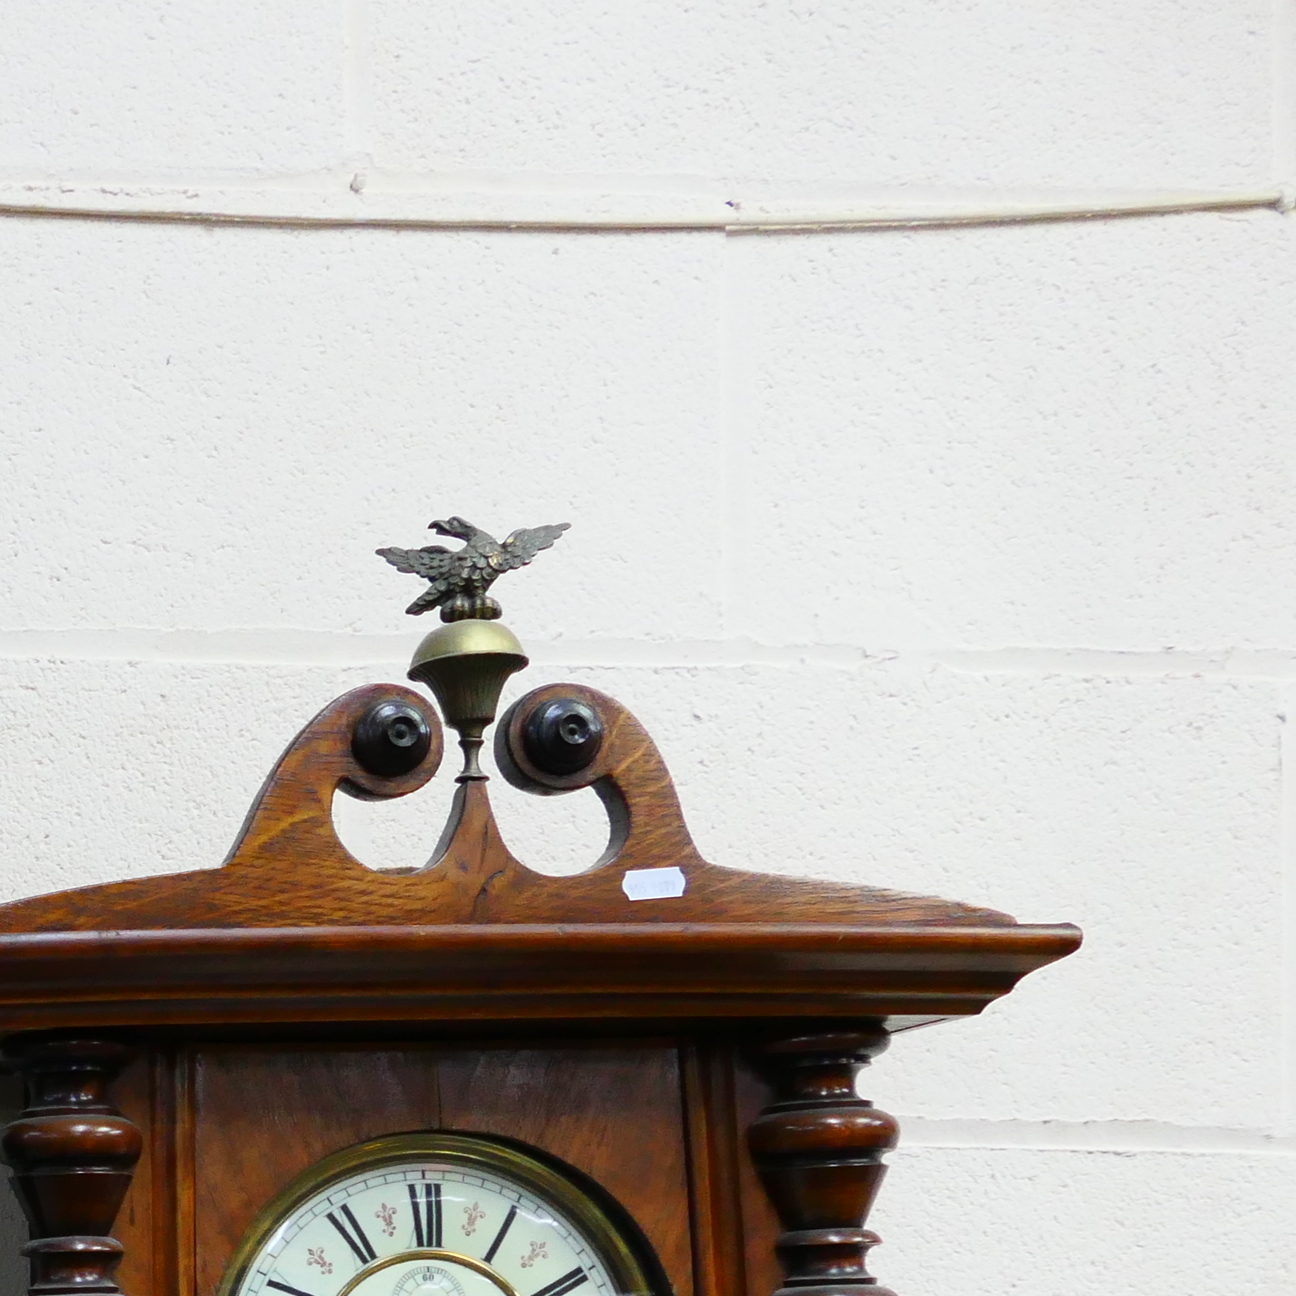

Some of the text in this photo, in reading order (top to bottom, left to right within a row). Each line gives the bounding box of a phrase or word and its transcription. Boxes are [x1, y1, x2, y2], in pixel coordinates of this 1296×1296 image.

[325, 1203, 377, 1265] XI
[408, 1183, 444, 1247] XII
[483, 1204, 519, 1264] I
[422, 1273, 434, 1282] 60
